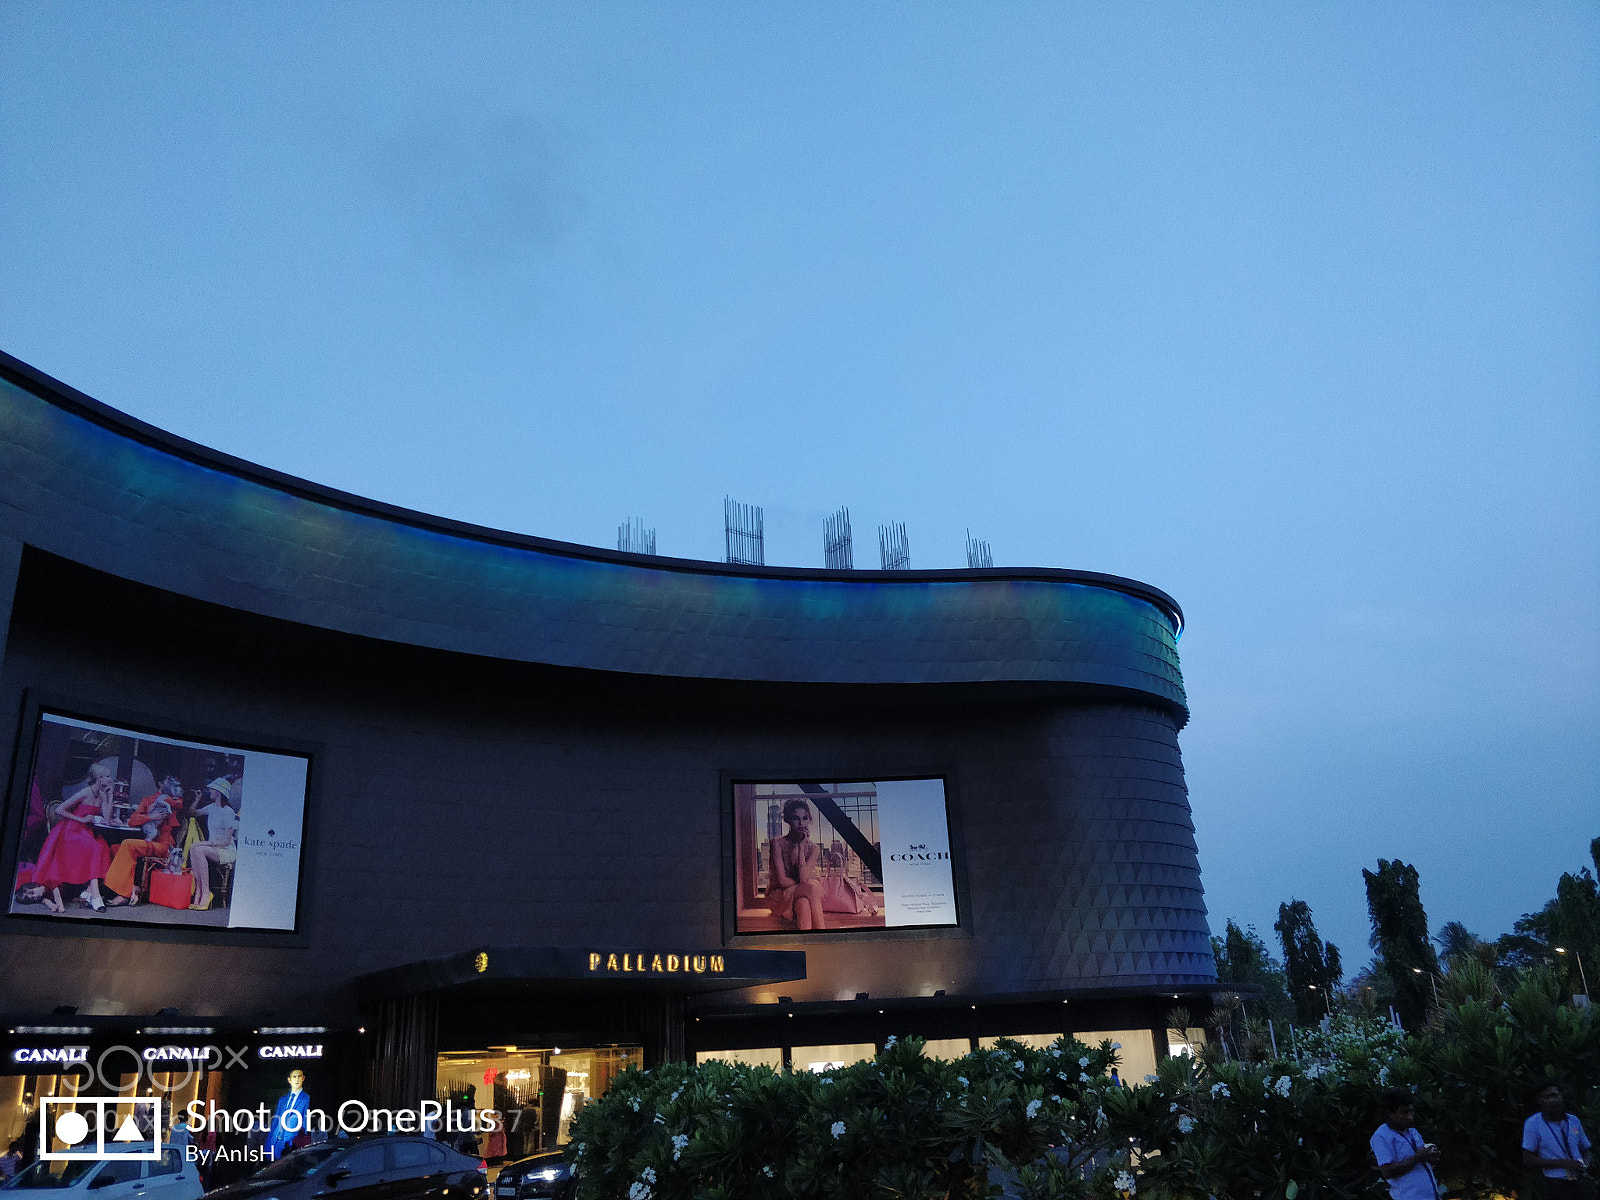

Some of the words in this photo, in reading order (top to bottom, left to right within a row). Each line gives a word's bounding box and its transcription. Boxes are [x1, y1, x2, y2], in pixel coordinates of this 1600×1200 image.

[244, 836, 265, 847] kate
[269, 840, 298, 850] spade
[890, 852, 949, 862] COACH
[588, 952, 726, 973] PALLADIUM
[14, 1048, 89, 1062] CANALI
[143, 1047, 211, 1060] CANALI
[259, 1045, 324, 1058] CANALI
